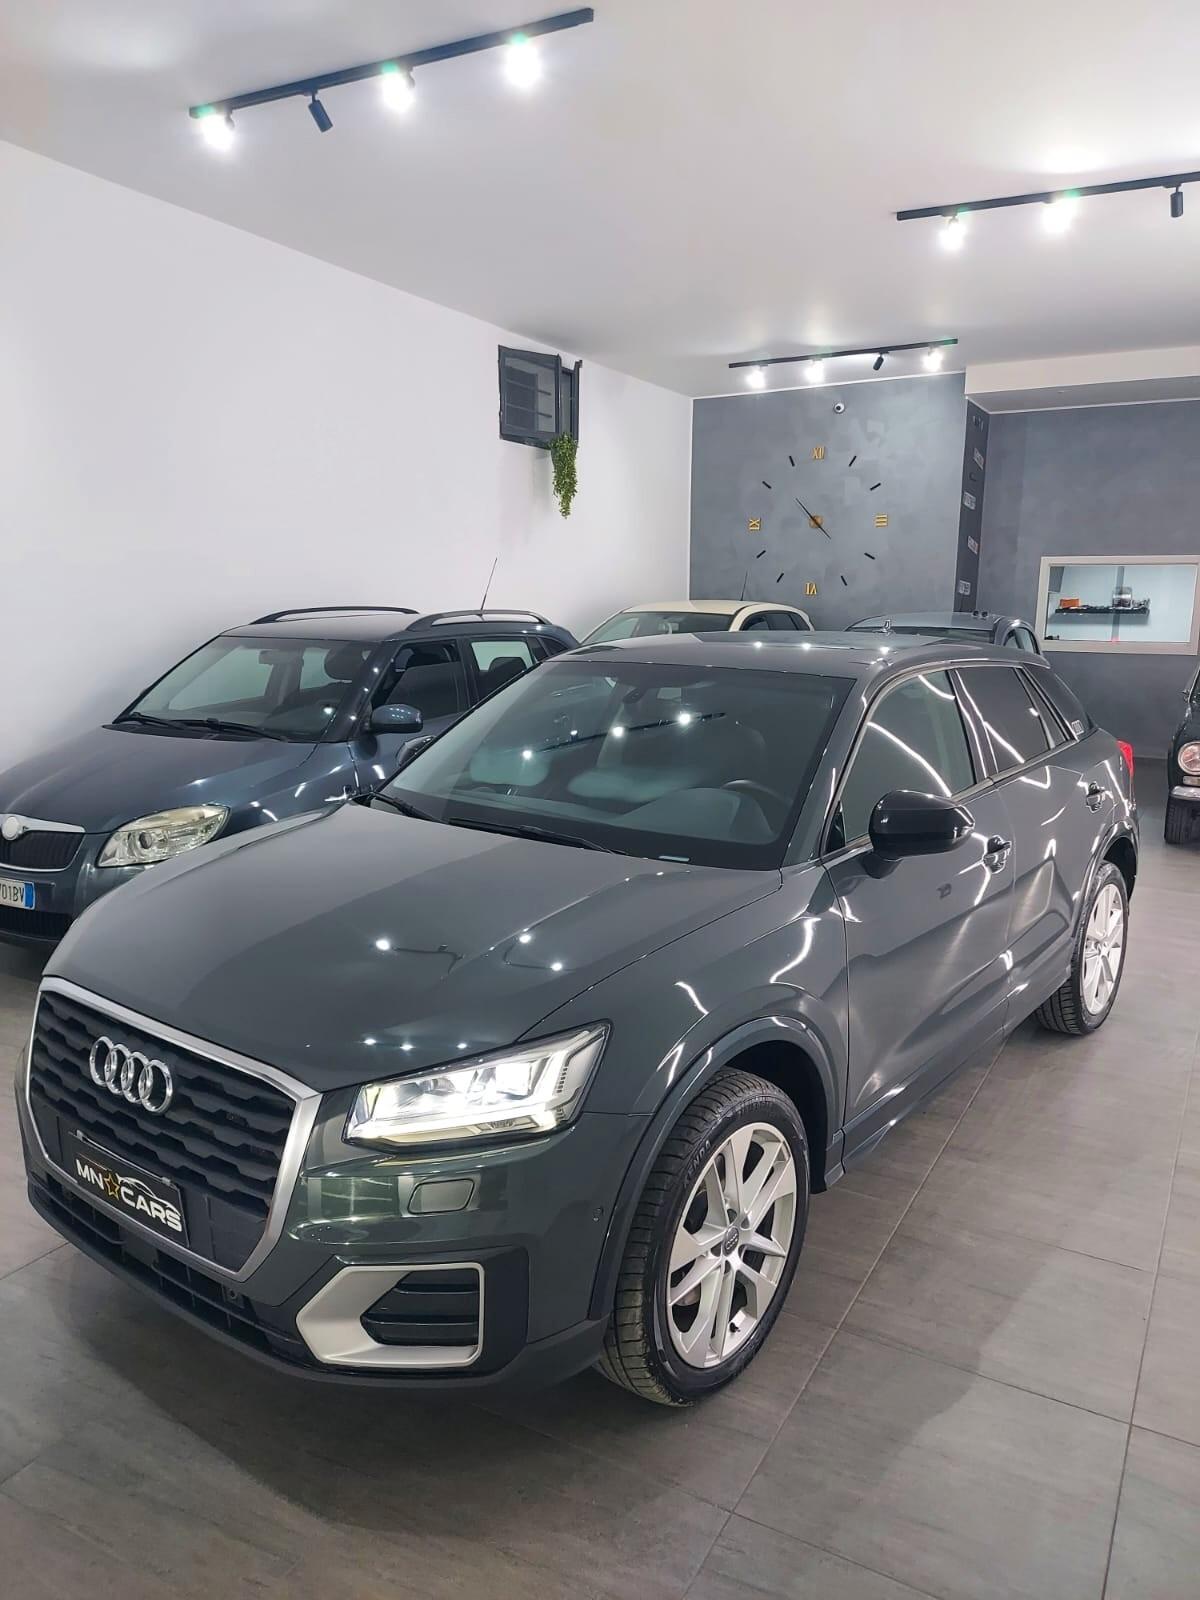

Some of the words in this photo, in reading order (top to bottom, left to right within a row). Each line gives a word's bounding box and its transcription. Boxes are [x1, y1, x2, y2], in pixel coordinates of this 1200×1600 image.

[875, 514, 888, 527] III
[0, 883, 24, 903] 01BV
[75, 1158, 105, 1190] MN
[120, 1186, 182, 1232] CARS
